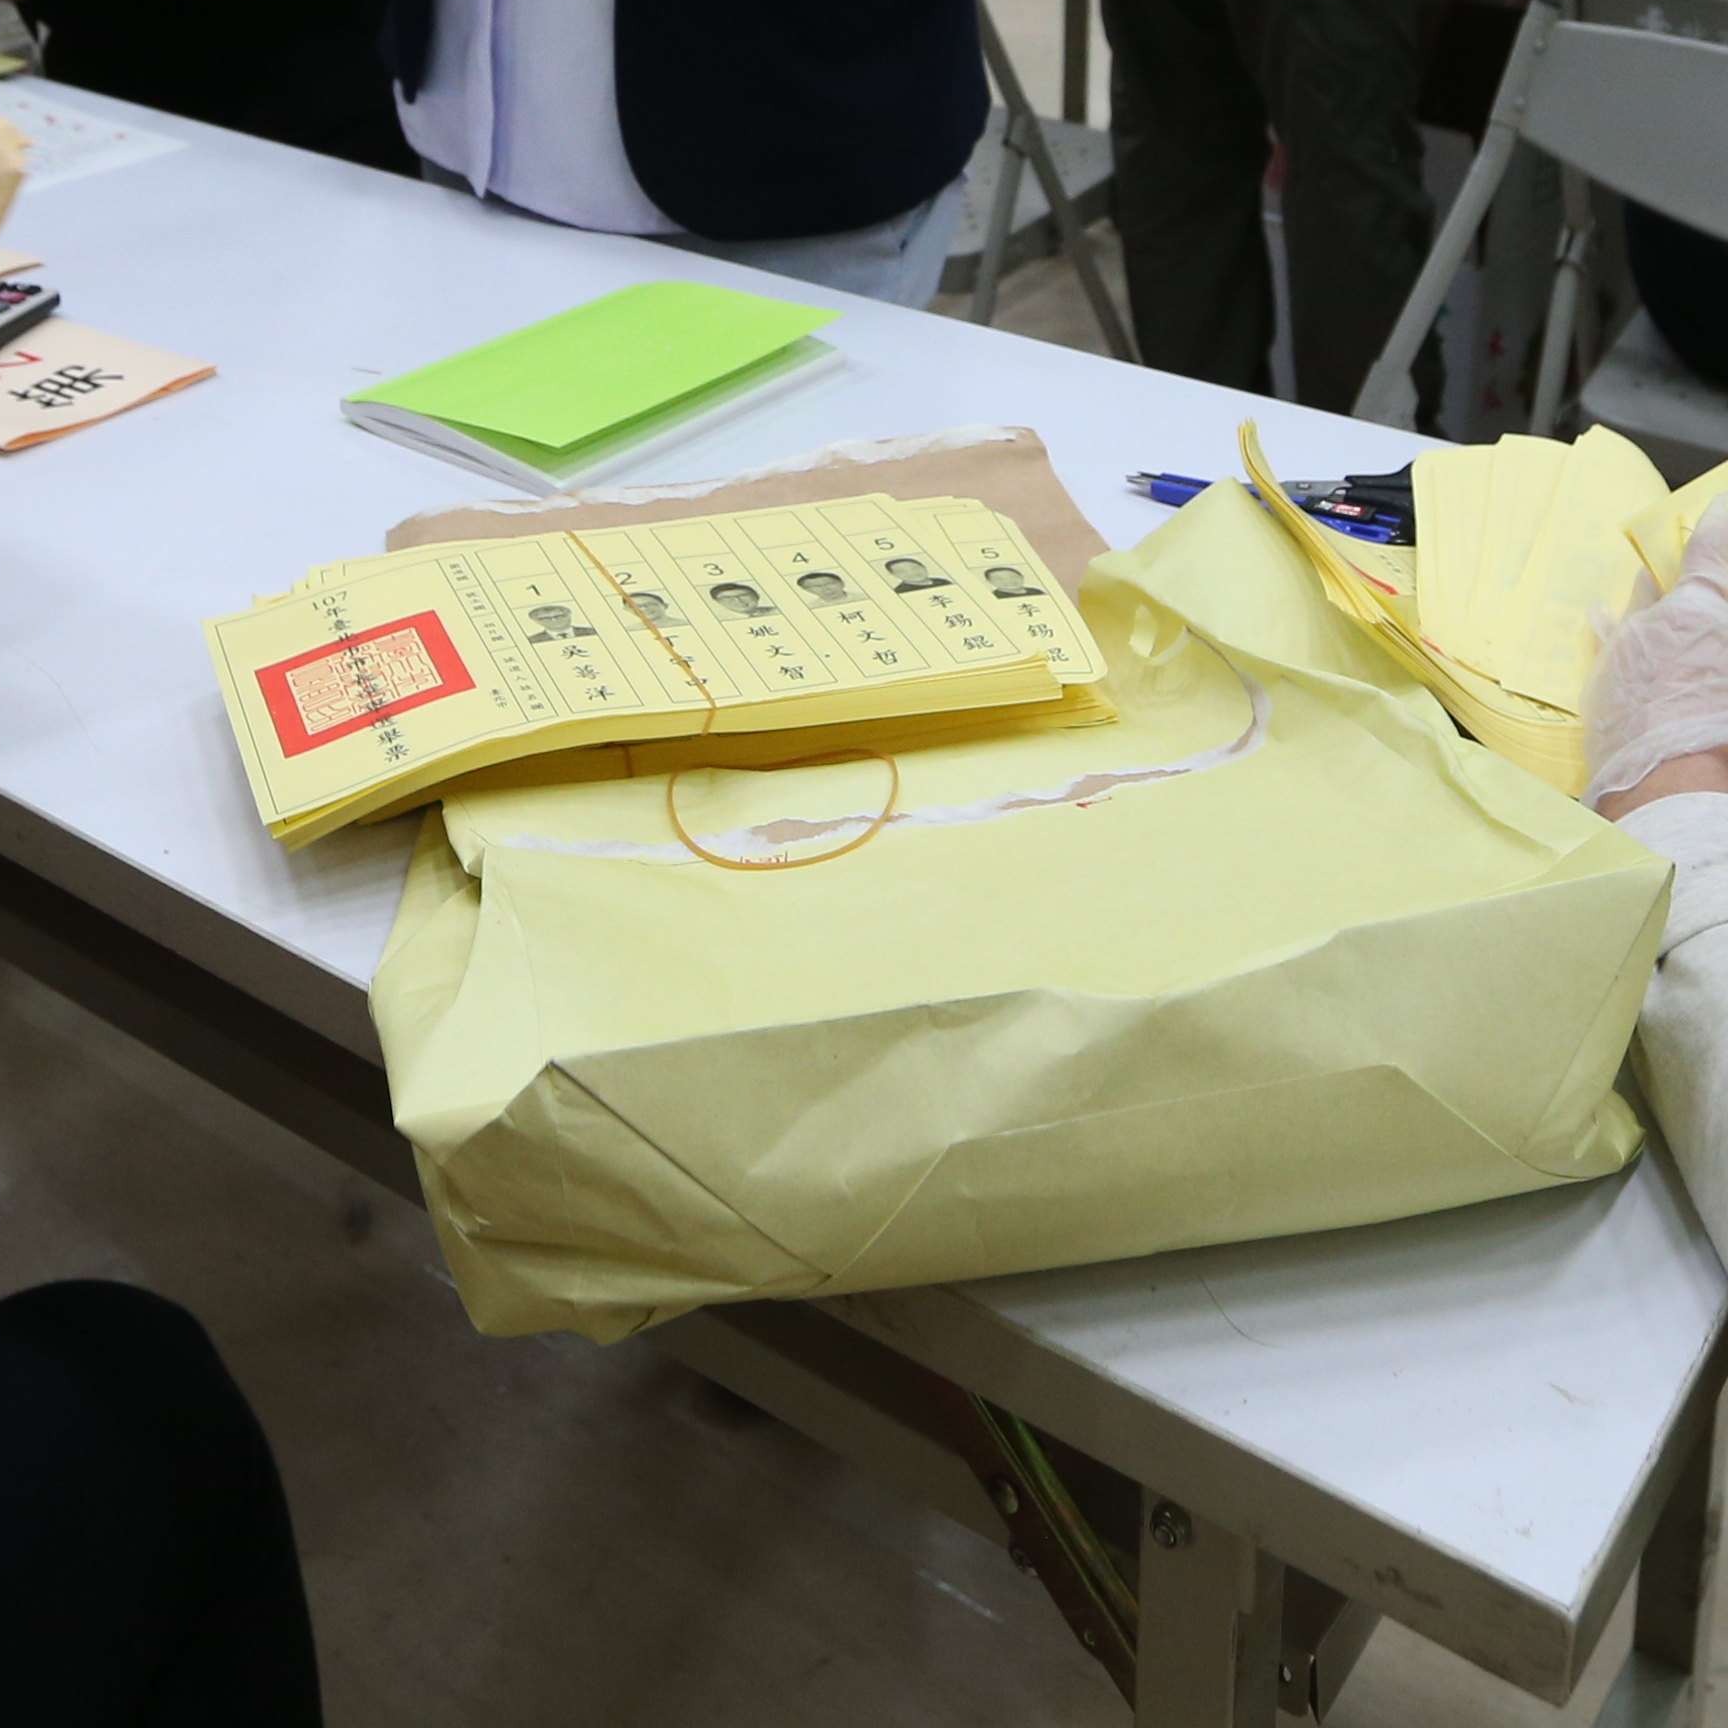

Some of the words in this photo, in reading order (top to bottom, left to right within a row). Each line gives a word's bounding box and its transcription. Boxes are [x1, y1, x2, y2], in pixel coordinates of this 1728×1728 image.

[873, 536, 895, 551] 5
[791, 551, 810, 565] 4
[980, 546, 1001, 560] 5
[702, 562, 725, 577] 3
[613, 571, 638, 587] 2
[525, 583, 542, 597] 1
[928, 593, 995, 652] 李錫錕
[835, 609, 900, 666] 柯文哲
[746, 624, 805, 681] 姚文智
